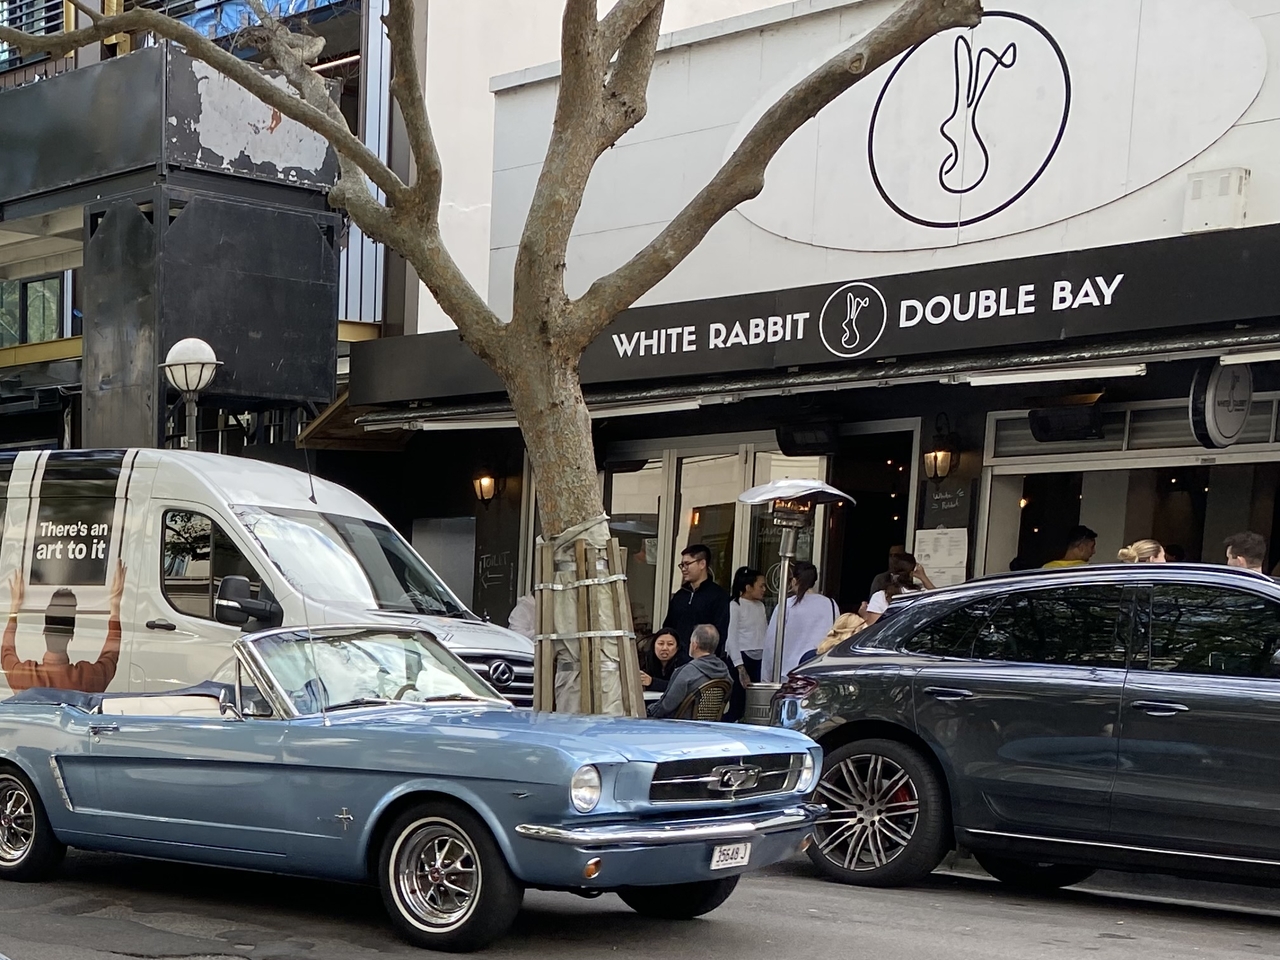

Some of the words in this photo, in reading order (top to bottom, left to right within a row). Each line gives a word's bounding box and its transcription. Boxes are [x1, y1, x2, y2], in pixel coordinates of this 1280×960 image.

[612, 324, 697, 358] WHITE
[709, 312, 810, 349] RABBIT
[899, 284, 1036, 329] DOUBLE
[1052, 274, 1125, 311] BAY
[40, 521, 88, 537] There's
[90, 523, 108, 536] an
[36, 540, 63, 560] art
[67, 540, 87, 560] to
[91, 539, 106, 559] it
